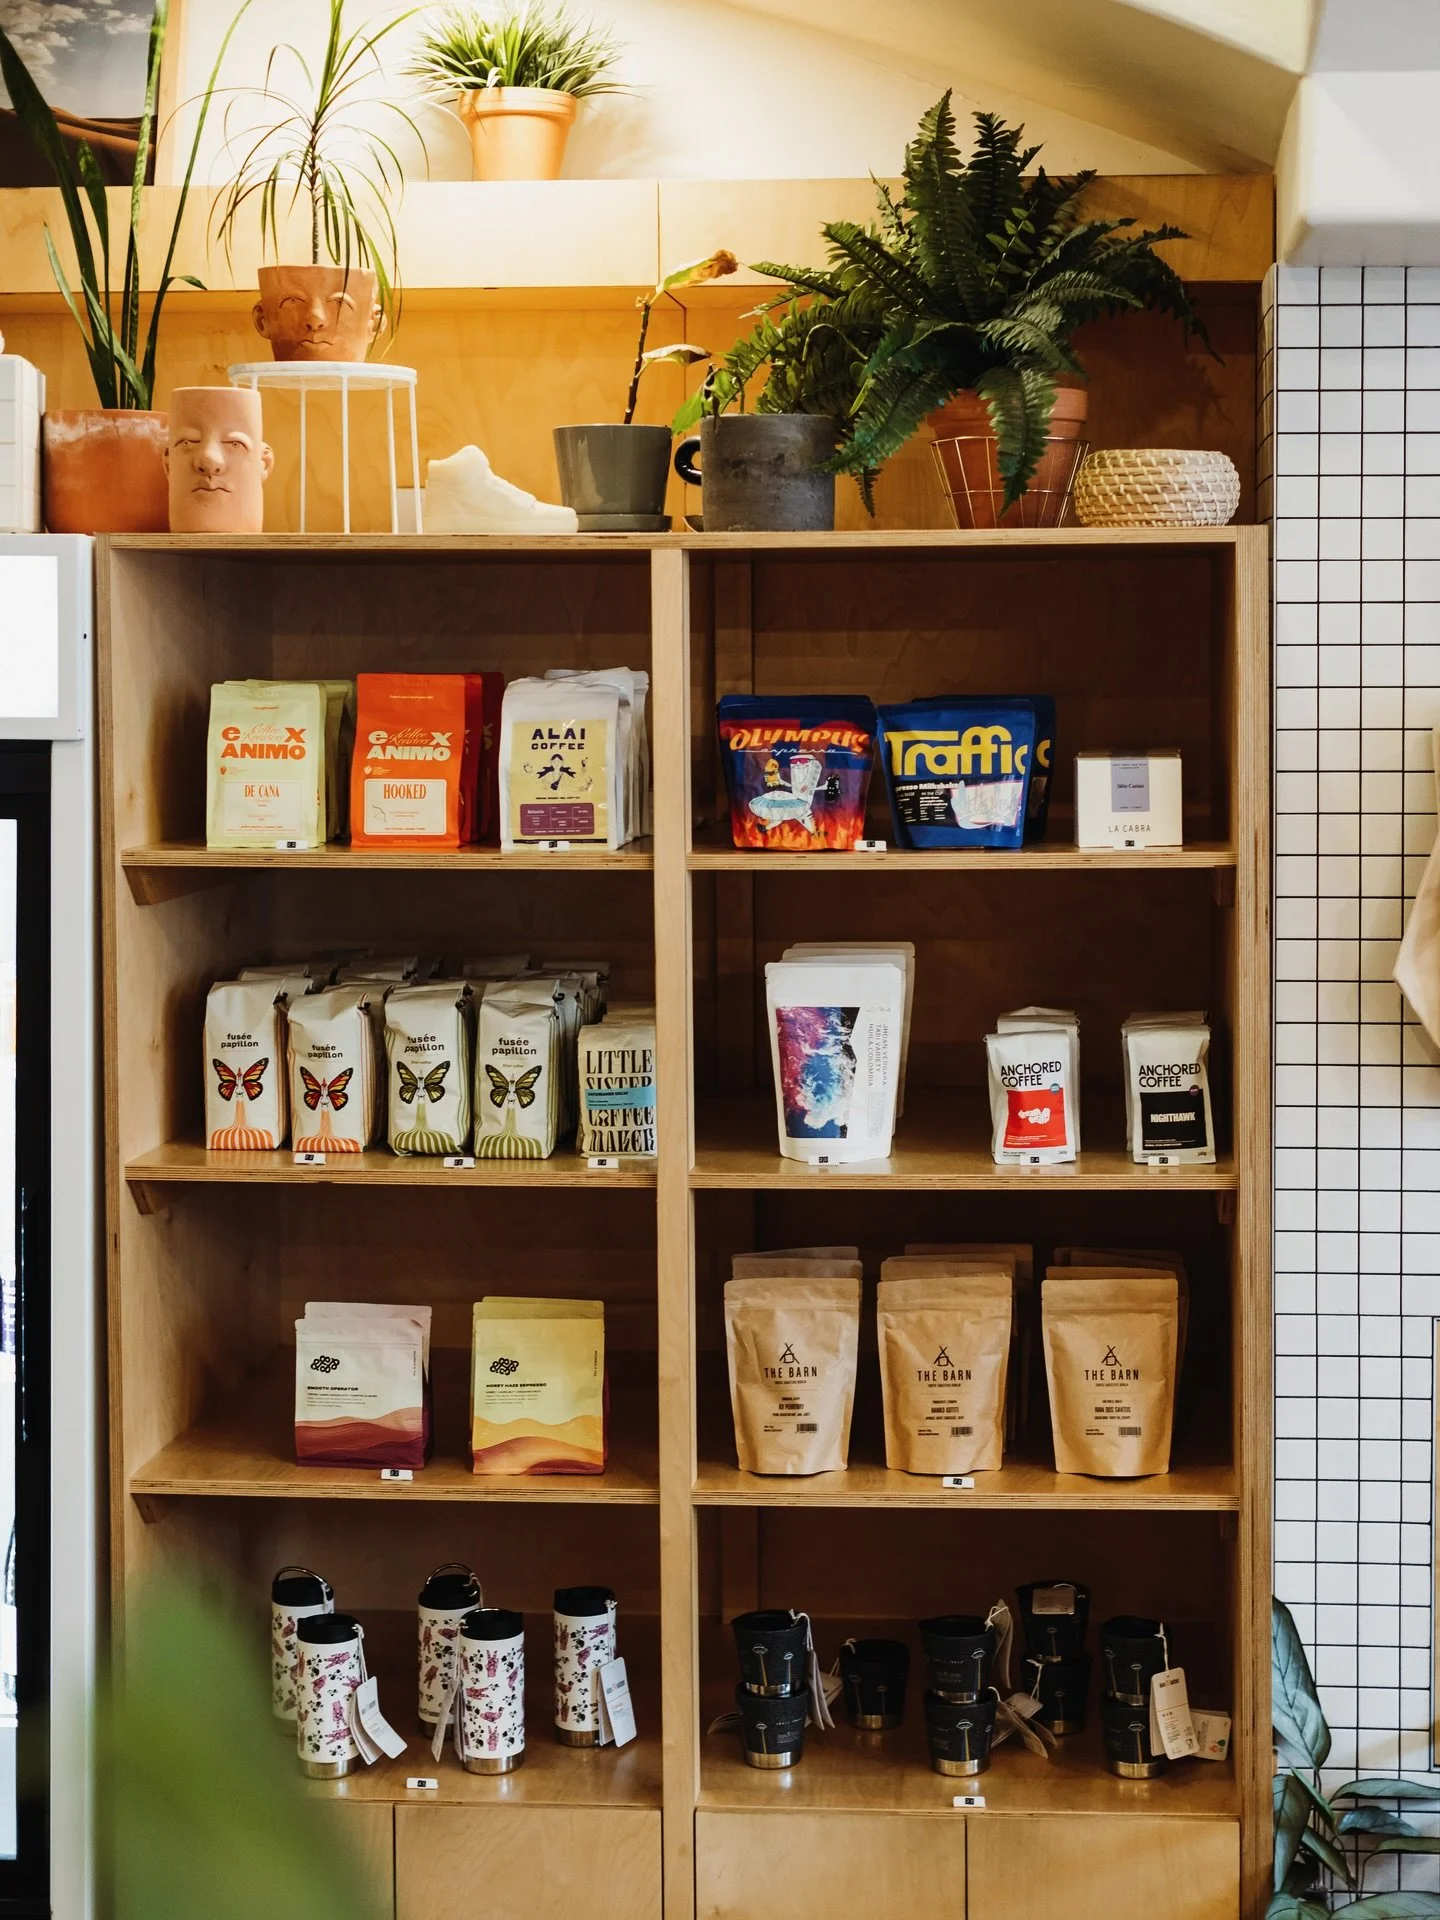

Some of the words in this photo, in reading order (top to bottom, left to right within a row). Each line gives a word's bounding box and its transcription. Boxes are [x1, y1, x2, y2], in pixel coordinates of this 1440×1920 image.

[531, 727, 586, 741] ALAI
[729, 728, 870, 753] OLYMPUS
[221, 743, 306, 760] ANIMO
[366, 744, 452, 762] ANIMO
[531, 742, 586, 751] COFFEE
[884, 725, 1029, 777] Traffic
[244, 784, 256, 798] DE
[383, 783, 428, 800] HOOKED
[1108, 825, 1120, 833] LA
[1122, 825, 1152, 833] CABRA
[227, 1032, 252, 1041] fusée
[407, 1034, 437, 1044] fusée
[498, 1037, 530, 1046] fusée
[221, 1041, 259, 1049] papillon
[404, 1043, 445, 1054] papillon
[492, 1046, 537, 1056] papillon
[307, 1051, 344, 1059] papillon
[585, 1049, 653, 1075] LITTLE
[1000, 1061, 1062, 1077] ANCHORED
[1138, 1063, 1201, 1077] ANCHORED
[1001, 1074, 1043, 1088] COFFEE
[1139, 1075, 1182, 1088] COFFEE
[1150, 1111, 1196, 1123] NIGHTHAWK
[588, 1128, 655, 1153] MAKER
[763, 1367, 783, 1379] THE
[788, 1366, 818, 1378] BARN
[917, 1370, 937, 1382] THE
[942, 1370, 972, 1381] BARN
[1085, 1370, 1104, 1381] THE
[1110, 1369, 1139, 1380] BARN
